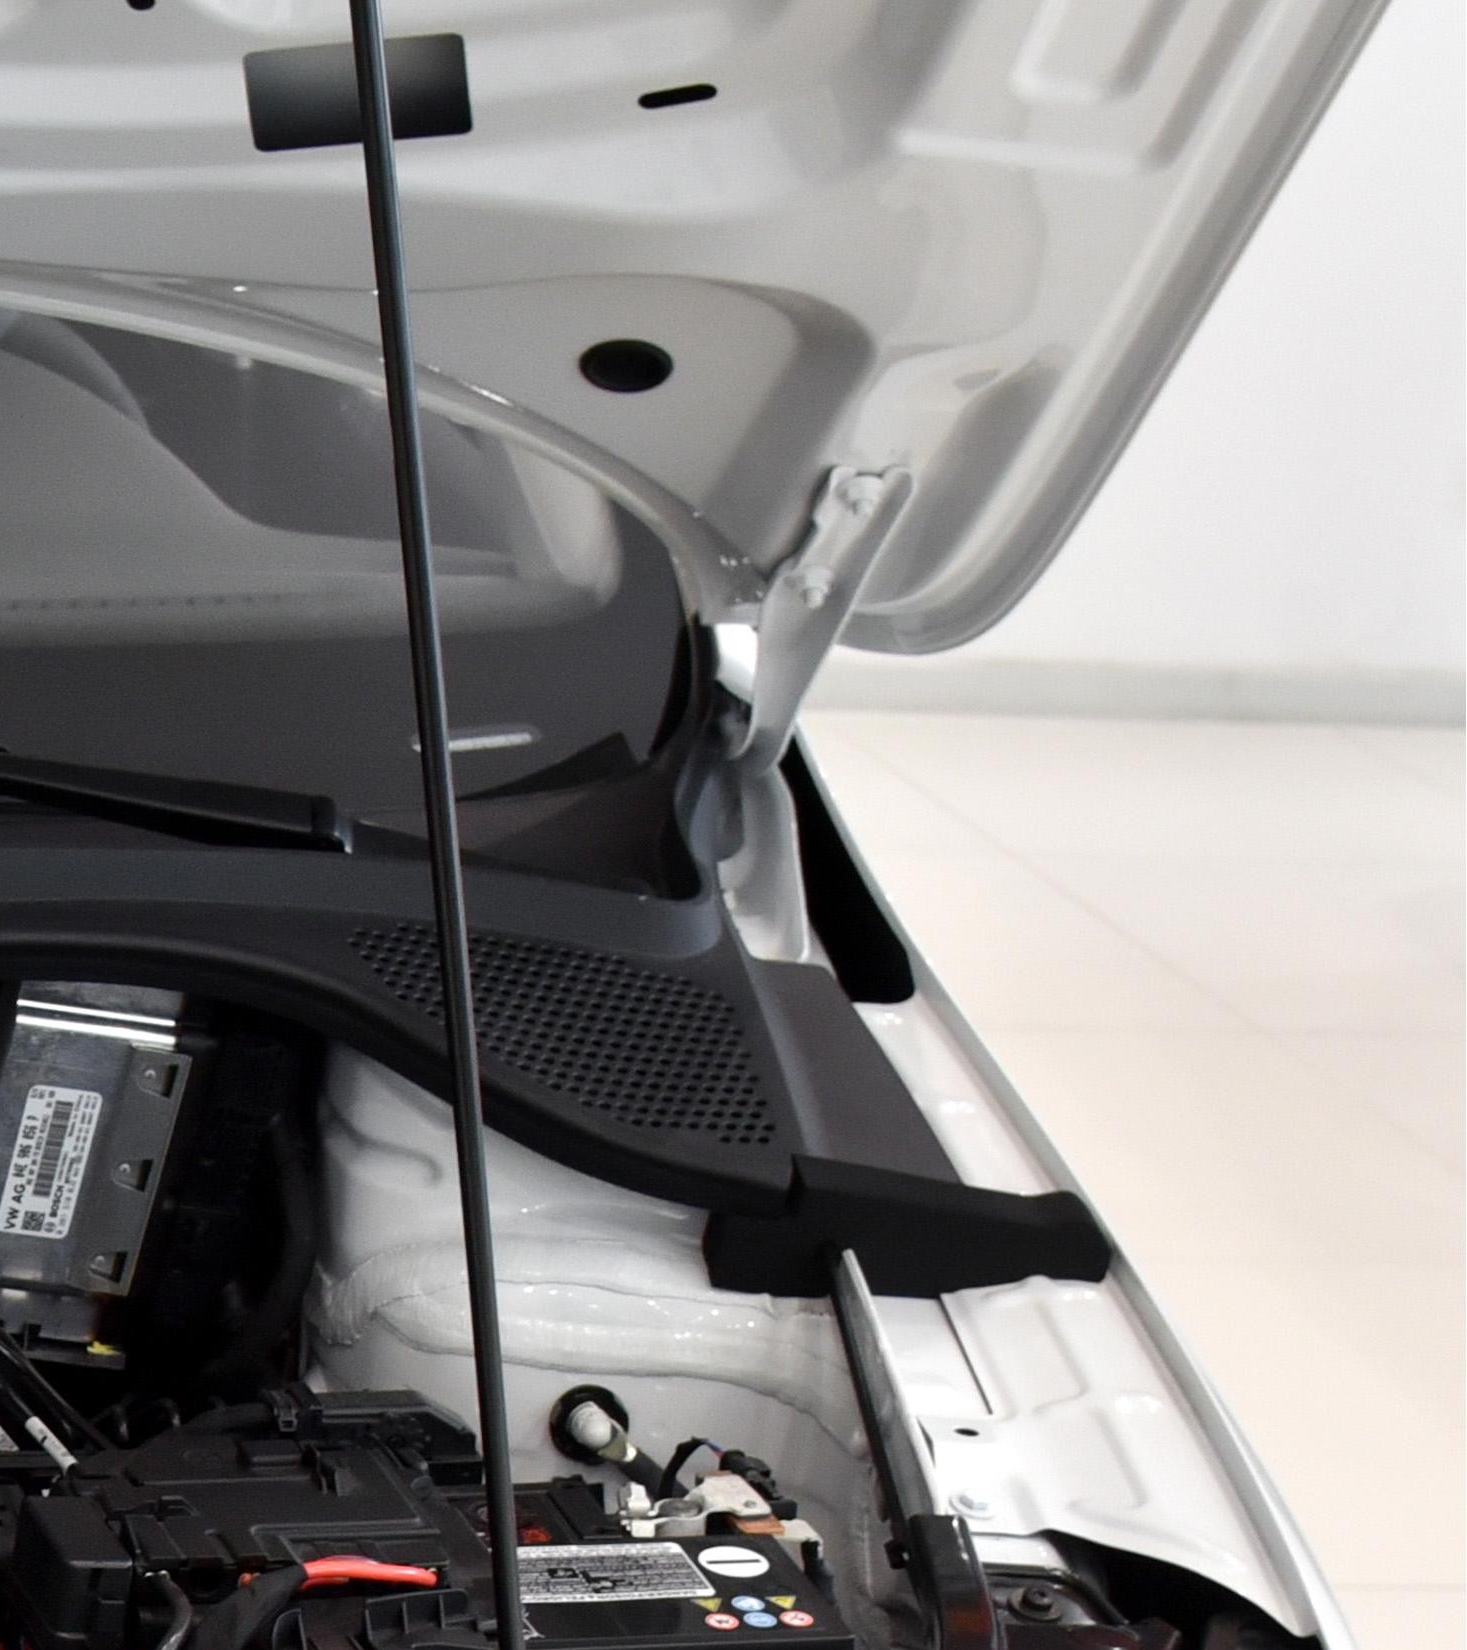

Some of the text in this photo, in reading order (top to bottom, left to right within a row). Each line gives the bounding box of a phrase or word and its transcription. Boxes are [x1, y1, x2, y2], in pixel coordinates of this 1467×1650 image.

[3, 1208, 19, 1229] VW
[11, 1184, 26, 1204] AG
[49, 1185, 64, 1218] BOSCH
